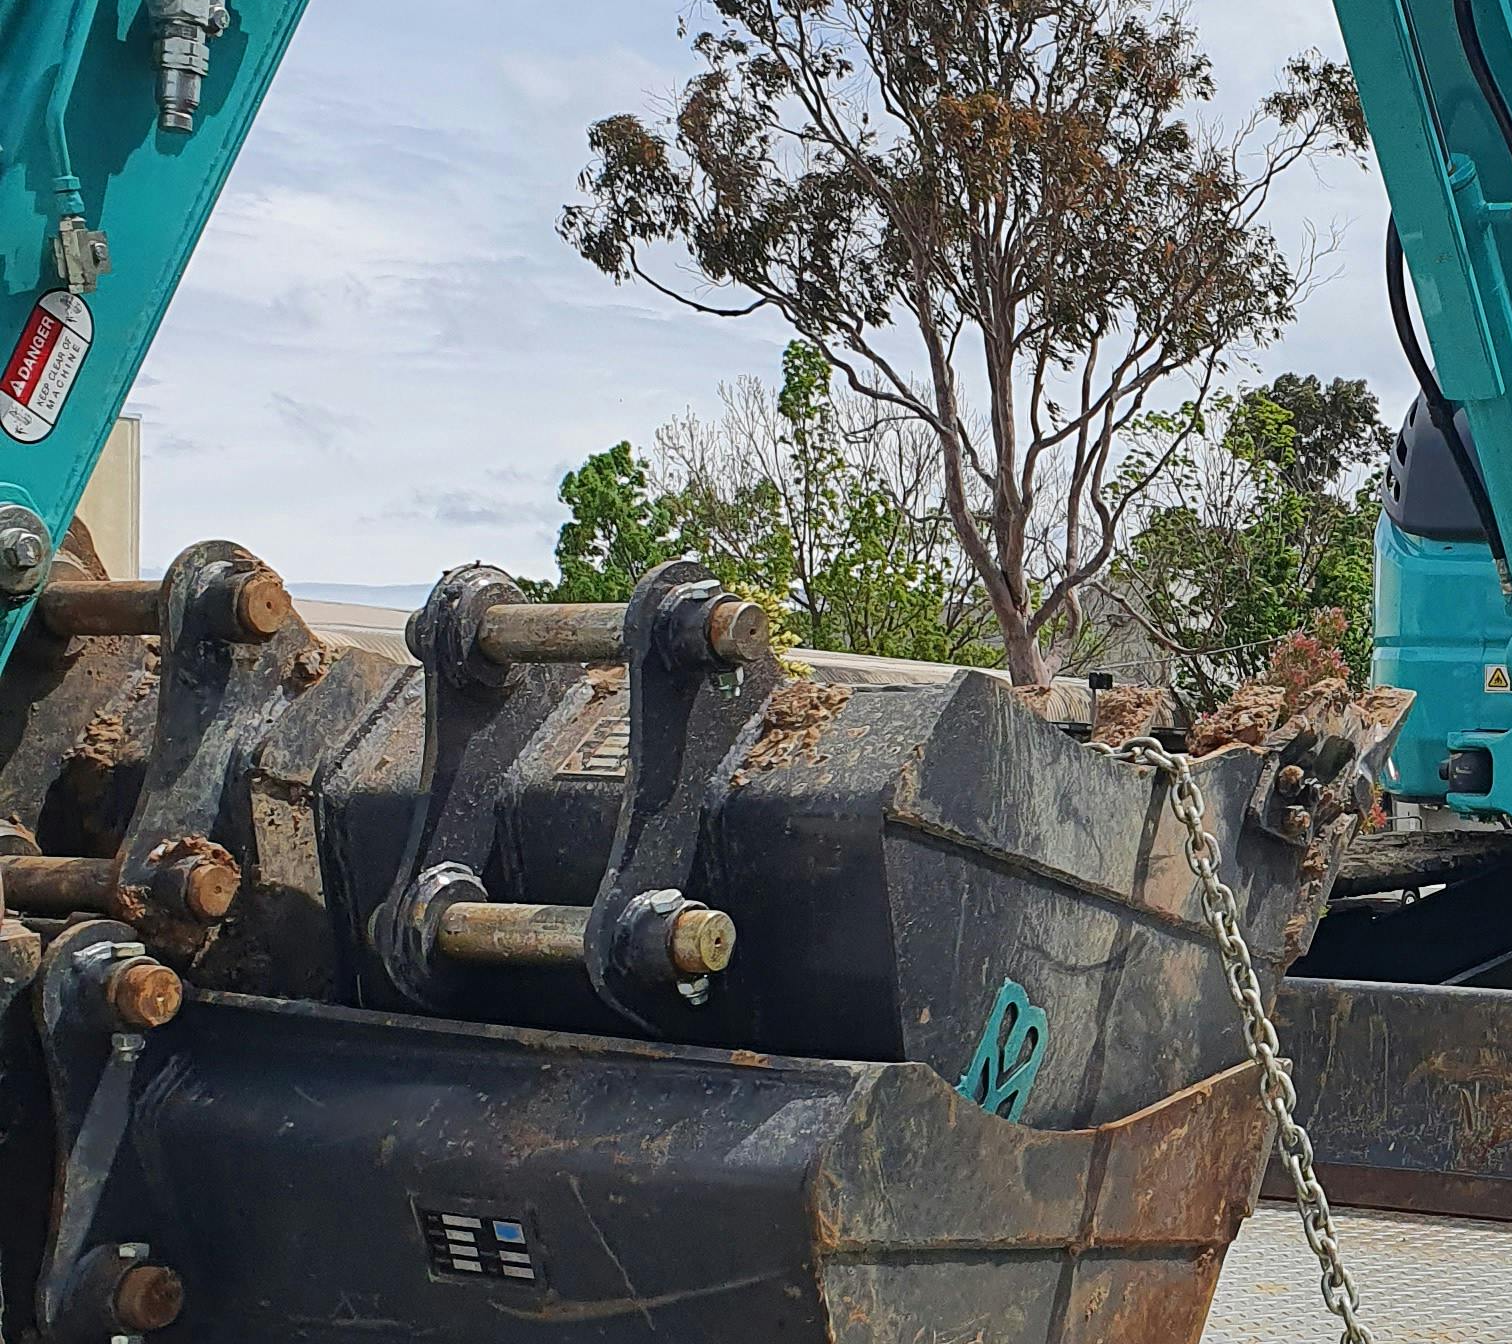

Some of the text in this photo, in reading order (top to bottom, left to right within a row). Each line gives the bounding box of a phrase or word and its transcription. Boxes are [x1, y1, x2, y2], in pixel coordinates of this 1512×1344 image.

[18, 315, 56, 381] DANGER
[37, 336, 72, 406] KEEP CLEAR OF
[46, 344, 81, 410] MACHINE
